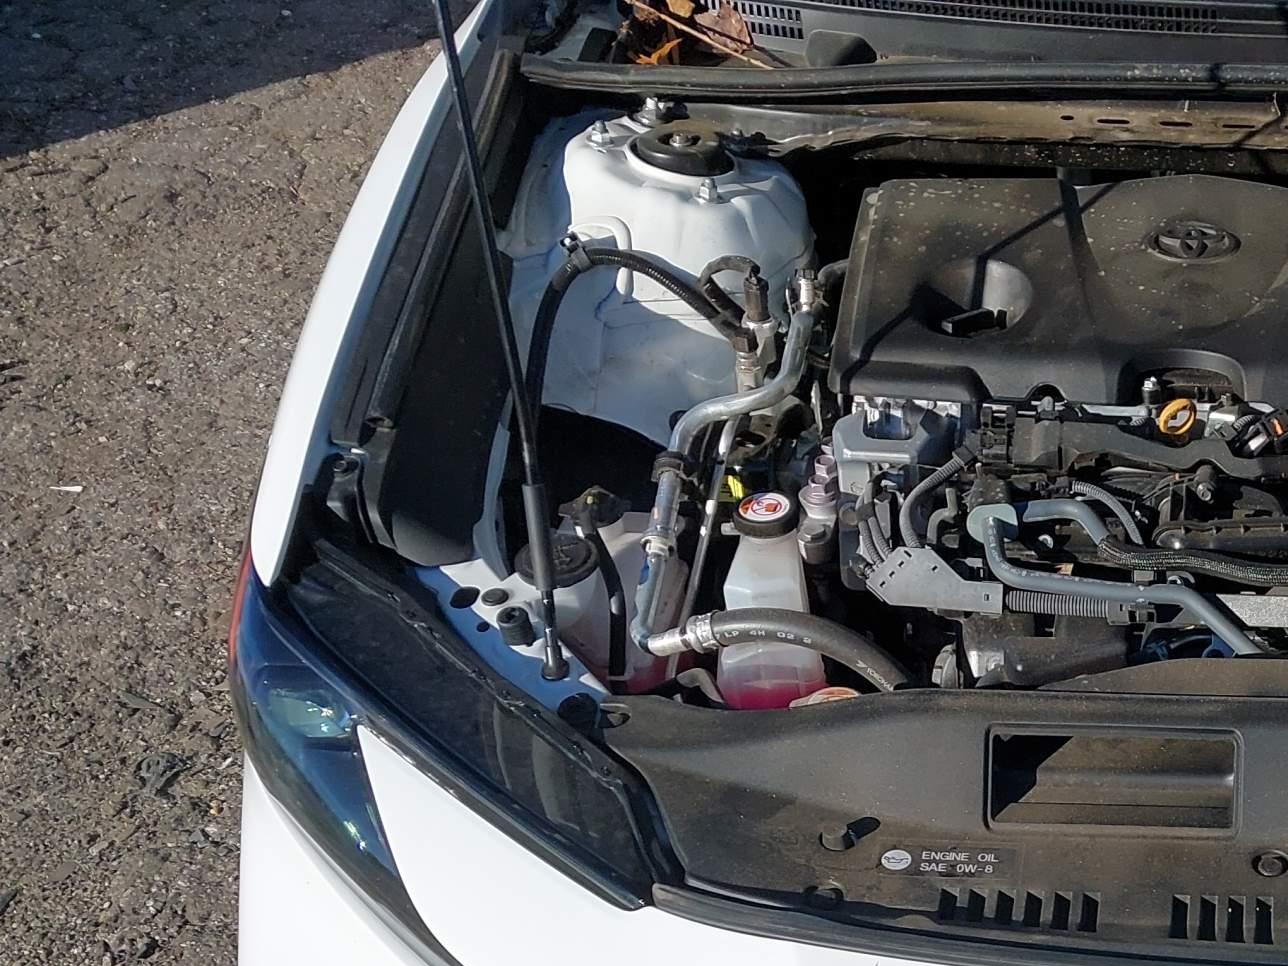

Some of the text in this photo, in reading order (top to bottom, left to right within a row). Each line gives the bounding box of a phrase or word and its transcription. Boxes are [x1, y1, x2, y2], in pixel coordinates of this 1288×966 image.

[921, 851, 1000, 863] ENGINE OIL
[919, 862, 993, 874] SAE 0W-8
